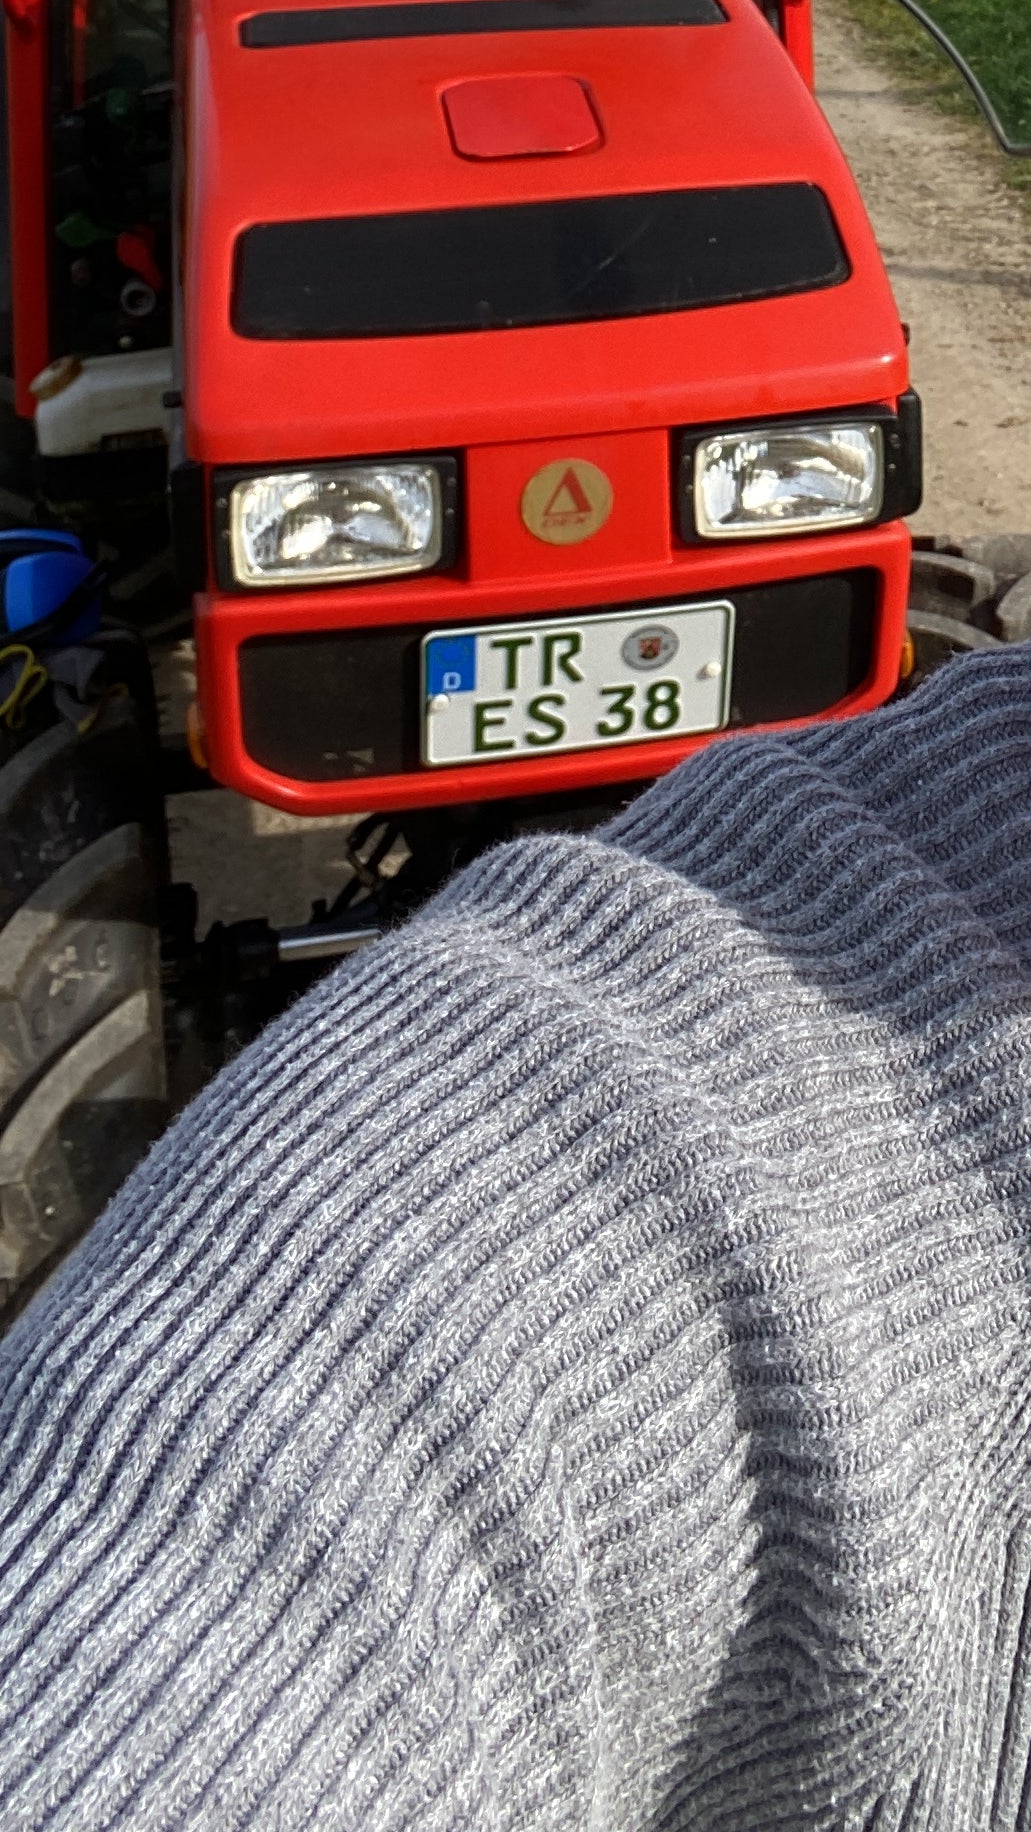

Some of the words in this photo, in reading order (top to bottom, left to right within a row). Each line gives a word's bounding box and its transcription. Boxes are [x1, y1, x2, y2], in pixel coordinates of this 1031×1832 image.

[443, 671, 461, 691] D
[490, 630, 584, 691] TR
[472, 693, 567, 753] ES
[595, 678, 682, 738] 38
